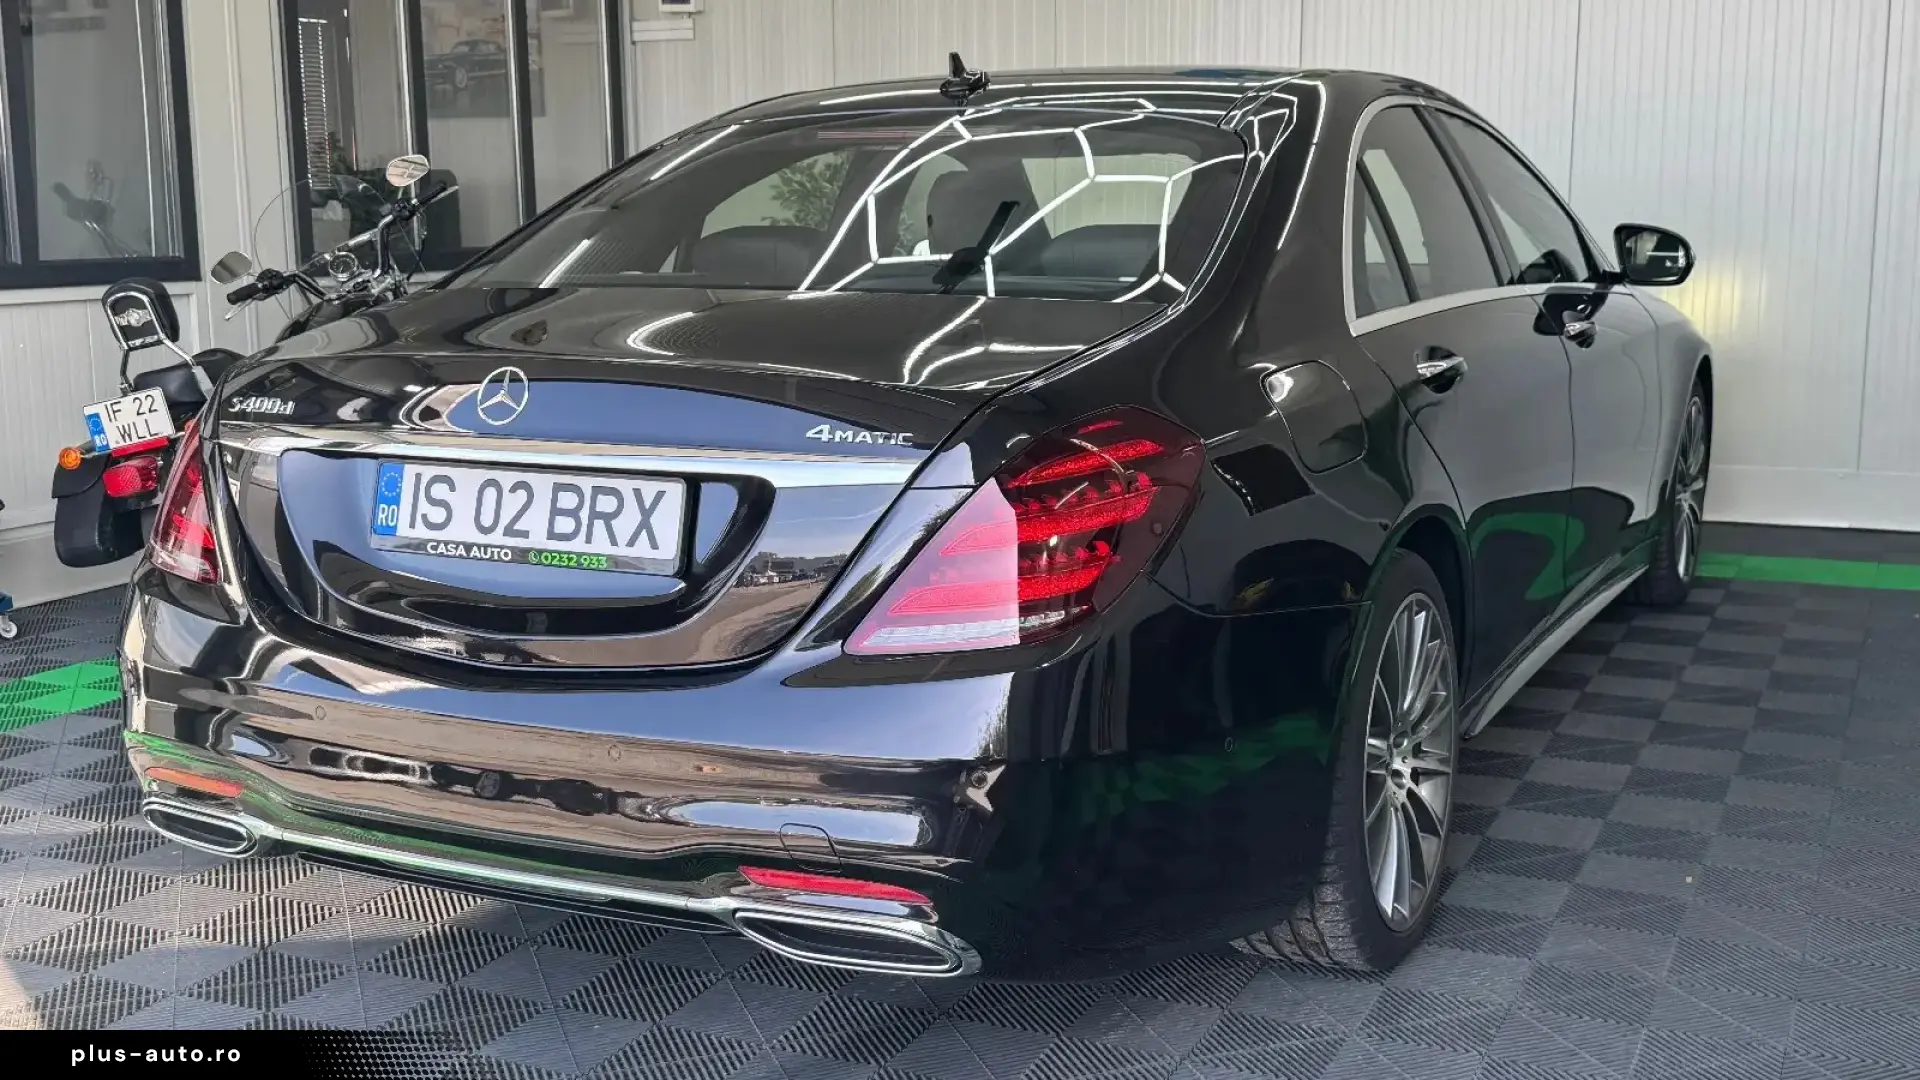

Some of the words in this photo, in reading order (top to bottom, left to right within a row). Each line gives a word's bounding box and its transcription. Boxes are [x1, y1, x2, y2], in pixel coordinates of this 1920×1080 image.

[104, 401, 122, 422] IF
[132, 394, 158, 416] 22
[227, 396, 295, 415] S400d
[116, 418, 160, 443] WLL
[805, 424, 914, 446] 4MATIC
[377, 503, 398, 526] RO
[408, 472, 456, 531] IS
[473, 478, 535, 539] 02
[546, 481, 667, 550] BRX
[426, 541, 467, 557] CASA
[469, 545, 512, 561] AUTO
[541, 552, 578, 567] 0232
[580, 555, 607, 569] 933
